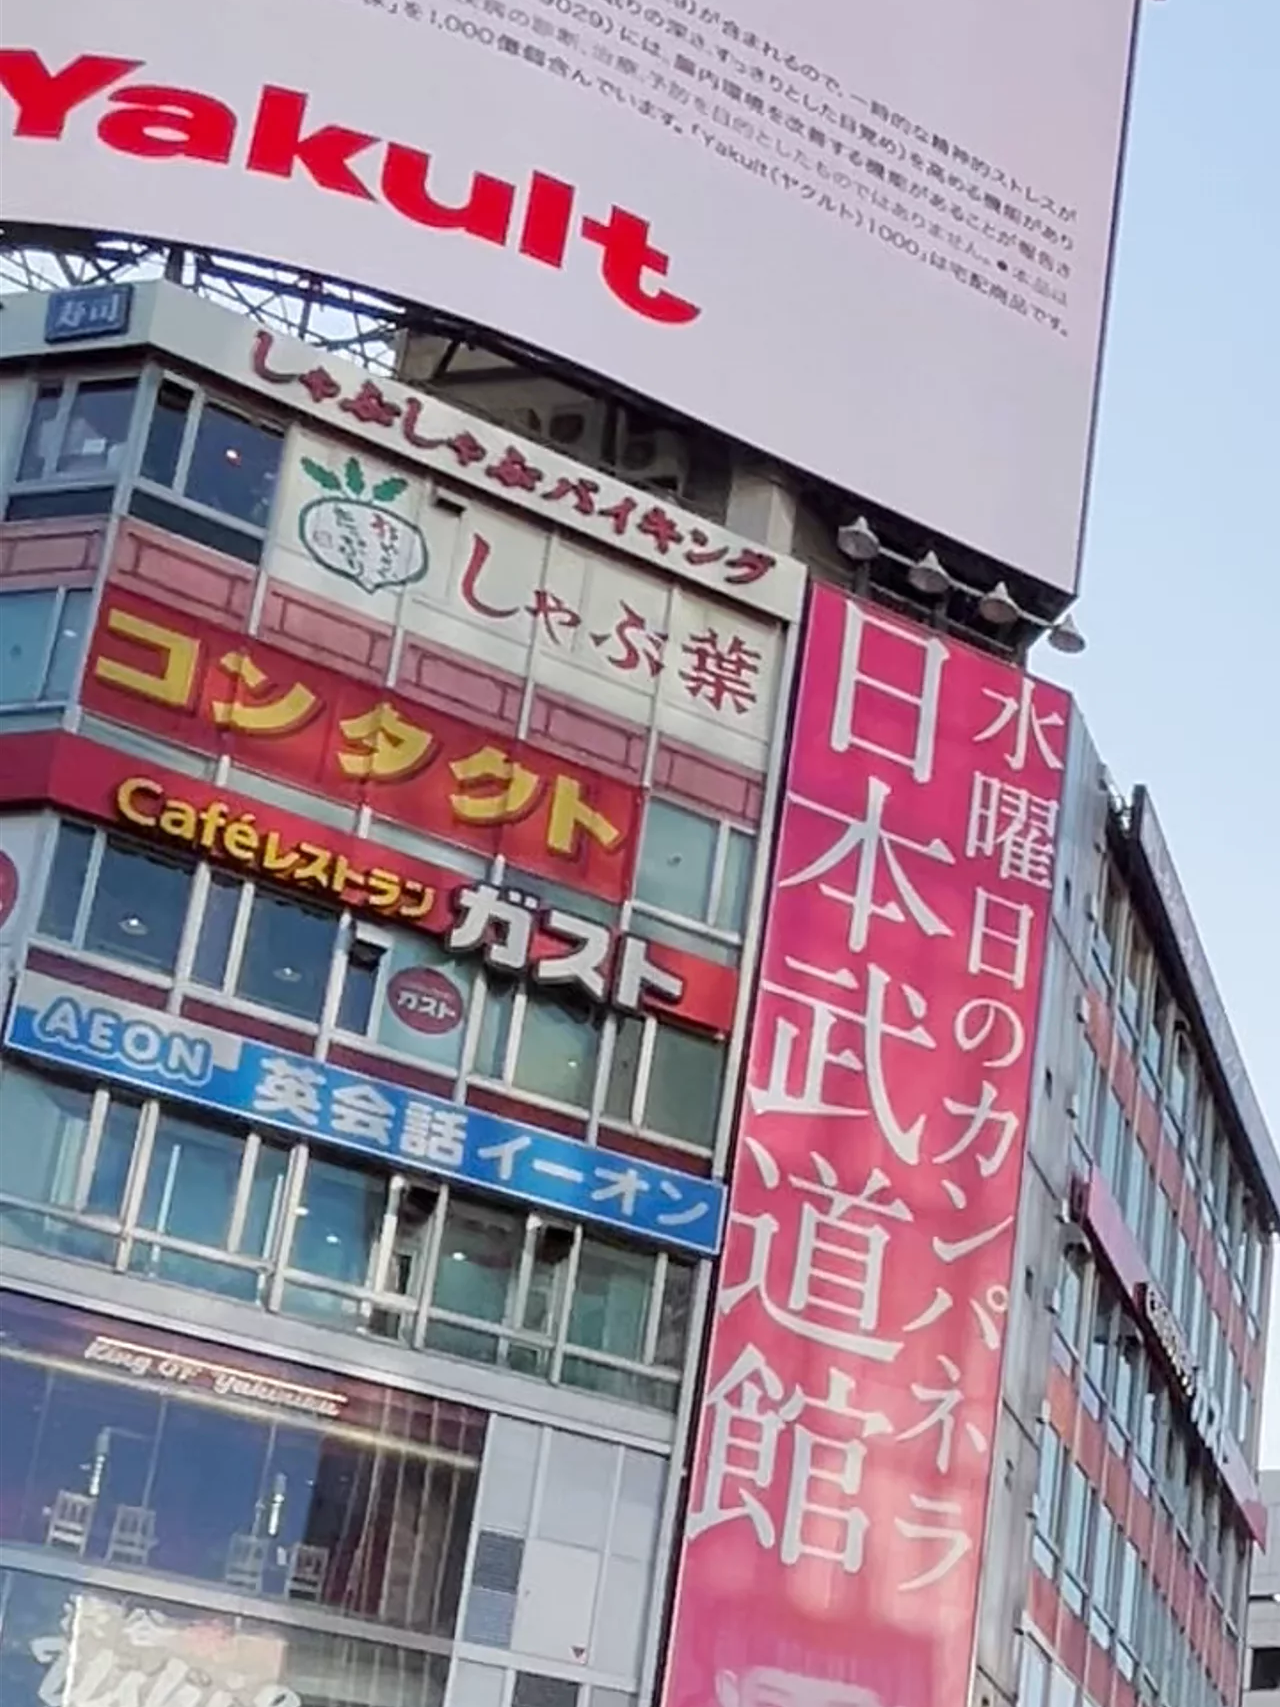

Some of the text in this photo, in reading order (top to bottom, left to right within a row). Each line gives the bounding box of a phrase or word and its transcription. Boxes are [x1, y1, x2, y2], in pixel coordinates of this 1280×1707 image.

[0, 49, 702, 324] Yakult
[252, 330, 777, 587] しゃぶしゃぶバイキング
[94, 609, 622, 856] コンタクト
[462, 532, 763, 717] しゃぶ葉
[398, 990, 456, 1020] ガスト
[450, 885, 686, 1013] ガスト
[37, 996, 711, 1227] AEON 英会話 イーオン
[684, 597, 953, 1577] 日本武道館
[893, 676, 1067, 1595] 水曜日のカンパネラ
